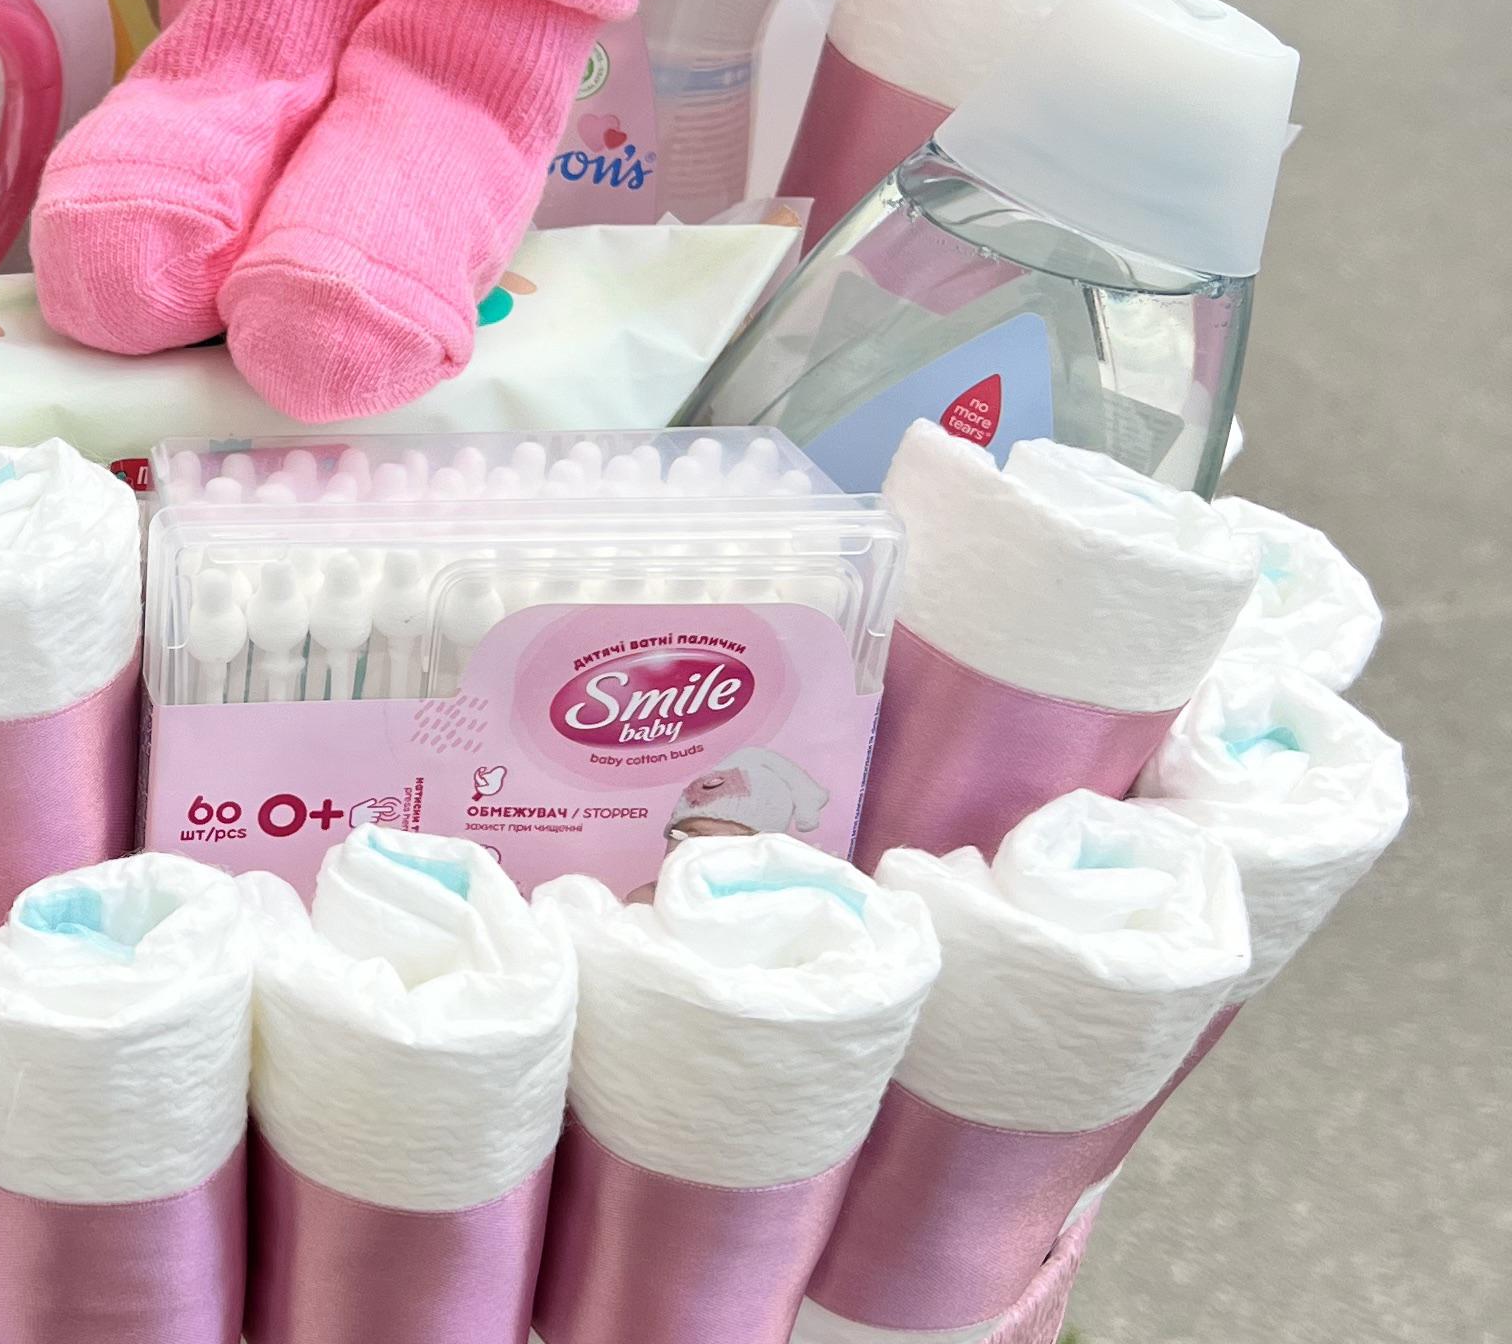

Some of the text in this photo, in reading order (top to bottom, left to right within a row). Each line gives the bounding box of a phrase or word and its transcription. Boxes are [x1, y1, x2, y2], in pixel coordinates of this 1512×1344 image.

[953, 405, 992, 429] more
[969, 398, 989, 413] no
[573, 633, 747, 671] дитячі ватні палички
[564, 664, 742, 730] Smile
[619, 718, 683, 743] baby
[590, 743, 705, 767] baby cotton buds
[187, 795, 242, 826] 60
[257, 793, 345, 838] 0+
[467, 806, 568, 818] ОБМЕЖУВАЧ
[583, 807, 649, 819] STOPPER
[180, 827, 247, 843] шт/pcs
[465, 823, 505, 832] захист
[508, 824, 532, 833] при
